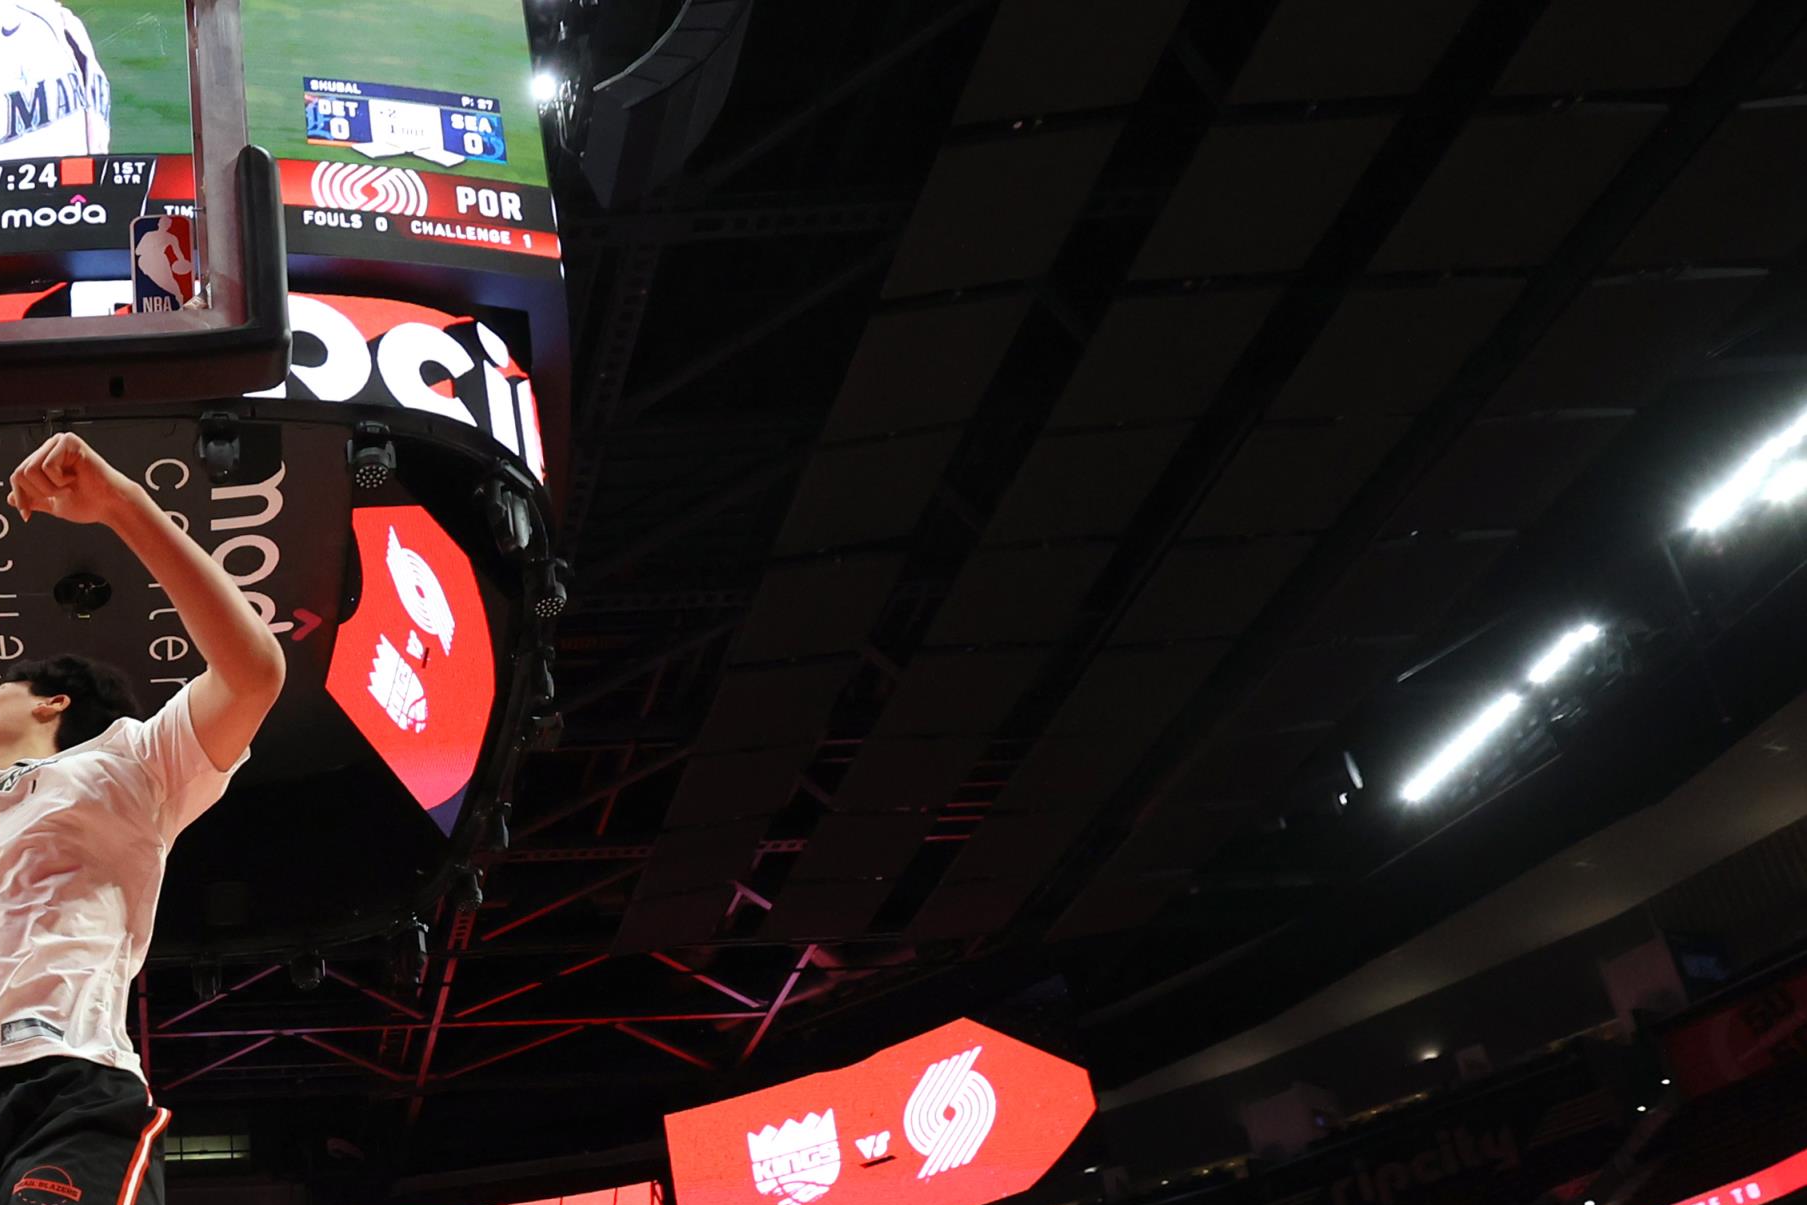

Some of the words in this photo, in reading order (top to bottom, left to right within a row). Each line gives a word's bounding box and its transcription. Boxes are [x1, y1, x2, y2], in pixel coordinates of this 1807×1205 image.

[317, 98, 360, 118] DET
[329, 117, 350, 141] 0
[450, 113, 493, 134] SEA
[463, 132, 484, 156] 0
[113, 161, 146, 175] 1ST
[1, 200, 107, 229] moda
[455, 185, 523, 221] POR
[303, 210, 363, 229] FOULS
[375, 216, 388, 232] 0
[410, 219, 512, 246] CHALLENGE
[522, 233, 533, 249] 1
[142, 295, 173, 313] NBA
[751, 1140, 842, 1184] KINGS
[1730, 1181, 1762, 1205] TO
